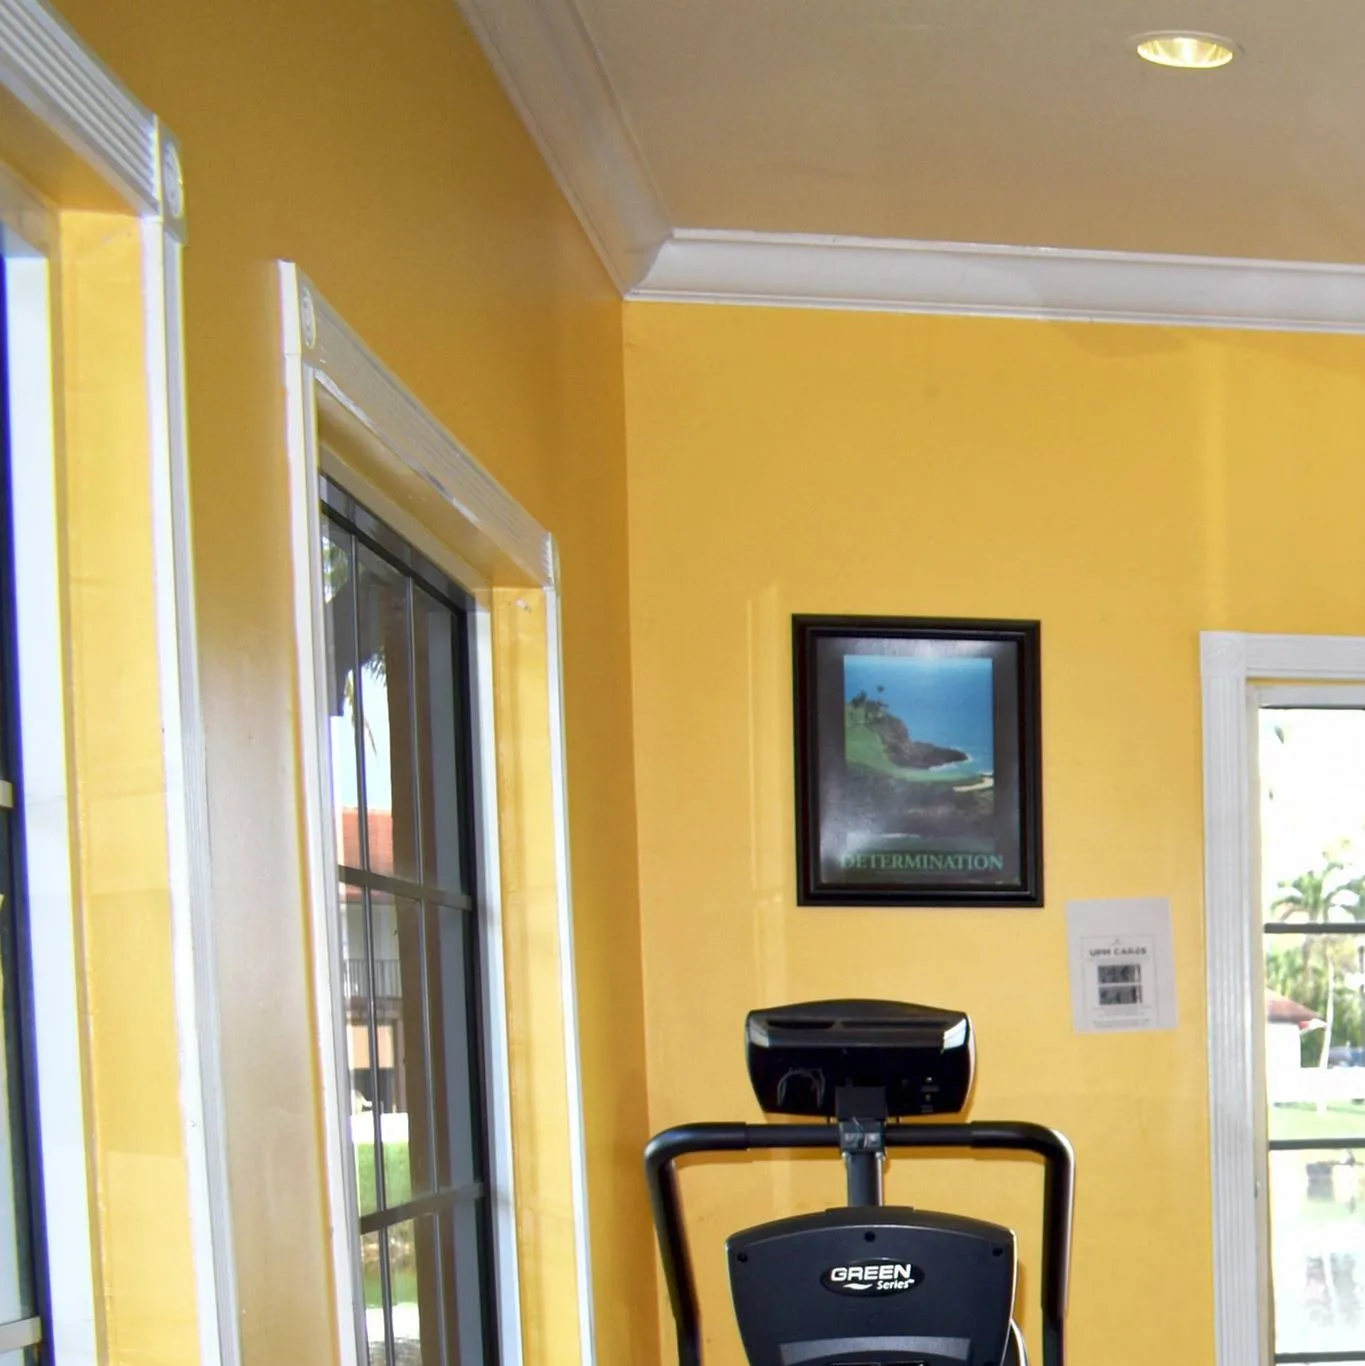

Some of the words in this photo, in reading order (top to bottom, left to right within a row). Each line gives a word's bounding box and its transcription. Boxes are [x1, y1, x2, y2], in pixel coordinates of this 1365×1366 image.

[840, 853, 1004, 870] DETERMINATION
[830, 1263, 911, 1282] GREEN
[876, 1279, 912, 1290] Series
